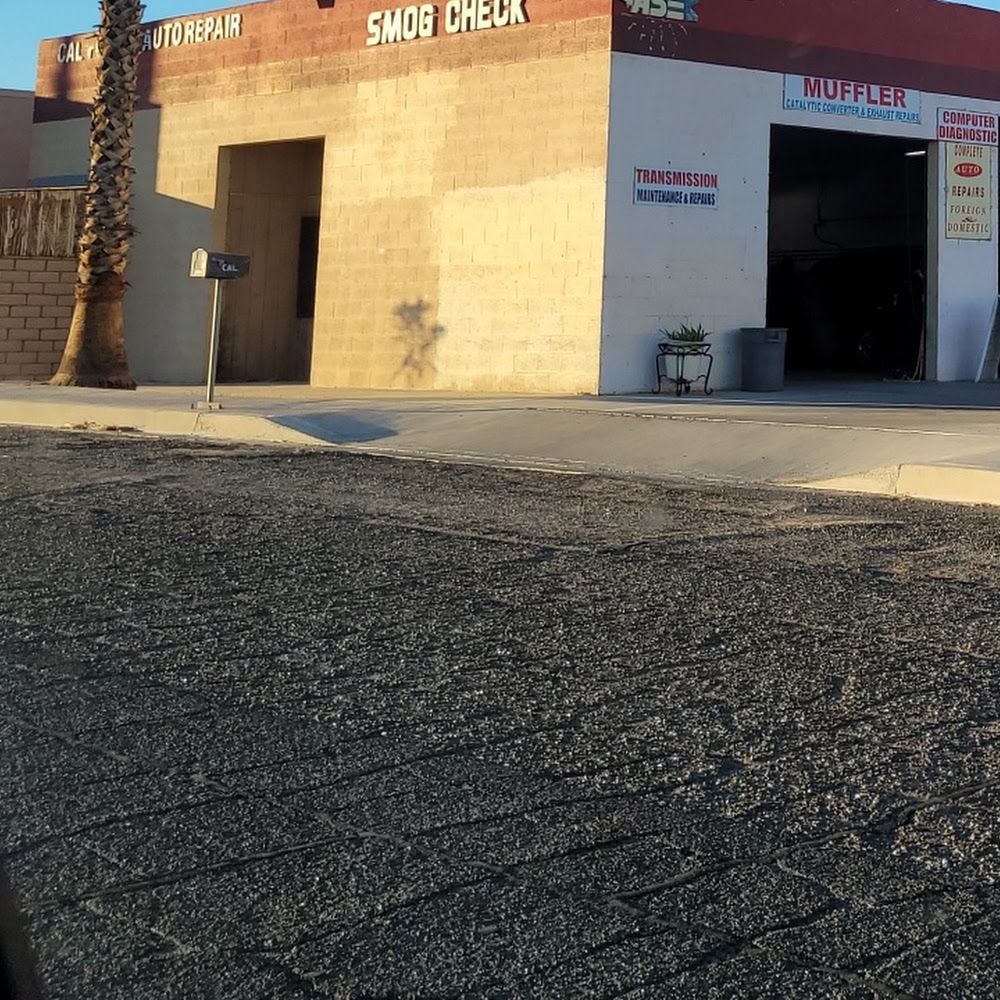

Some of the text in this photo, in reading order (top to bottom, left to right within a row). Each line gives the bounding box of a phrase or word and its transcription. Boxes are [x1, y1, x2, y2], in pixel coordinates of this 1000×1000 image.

[366, 4, 435, 46] SMOG
[57, 42, 82, 63] CAL
[185, 13, 242, 44] REPAIR
[803, 77, 906, 108] MUFFLER
[786, 98, 920, 121] CATALYTIC CONVERTER & EXHAUST REPAIRS
[943, 111, 995, 128] COMPUTER
[939, 125, 997, 143] DIAGNOSTIC
[636, 168, 718, 188] TRANSMISSION
[955, 165, 980, 174] AUTO
[637, 188, 715, 206] MAINTENANCE & REPAIRS
[952, 185, 985, 198] REPAIRS
[950, 205, 986, 216] FOREIGN
[948, 223, 989, 233] DOMESTIC
